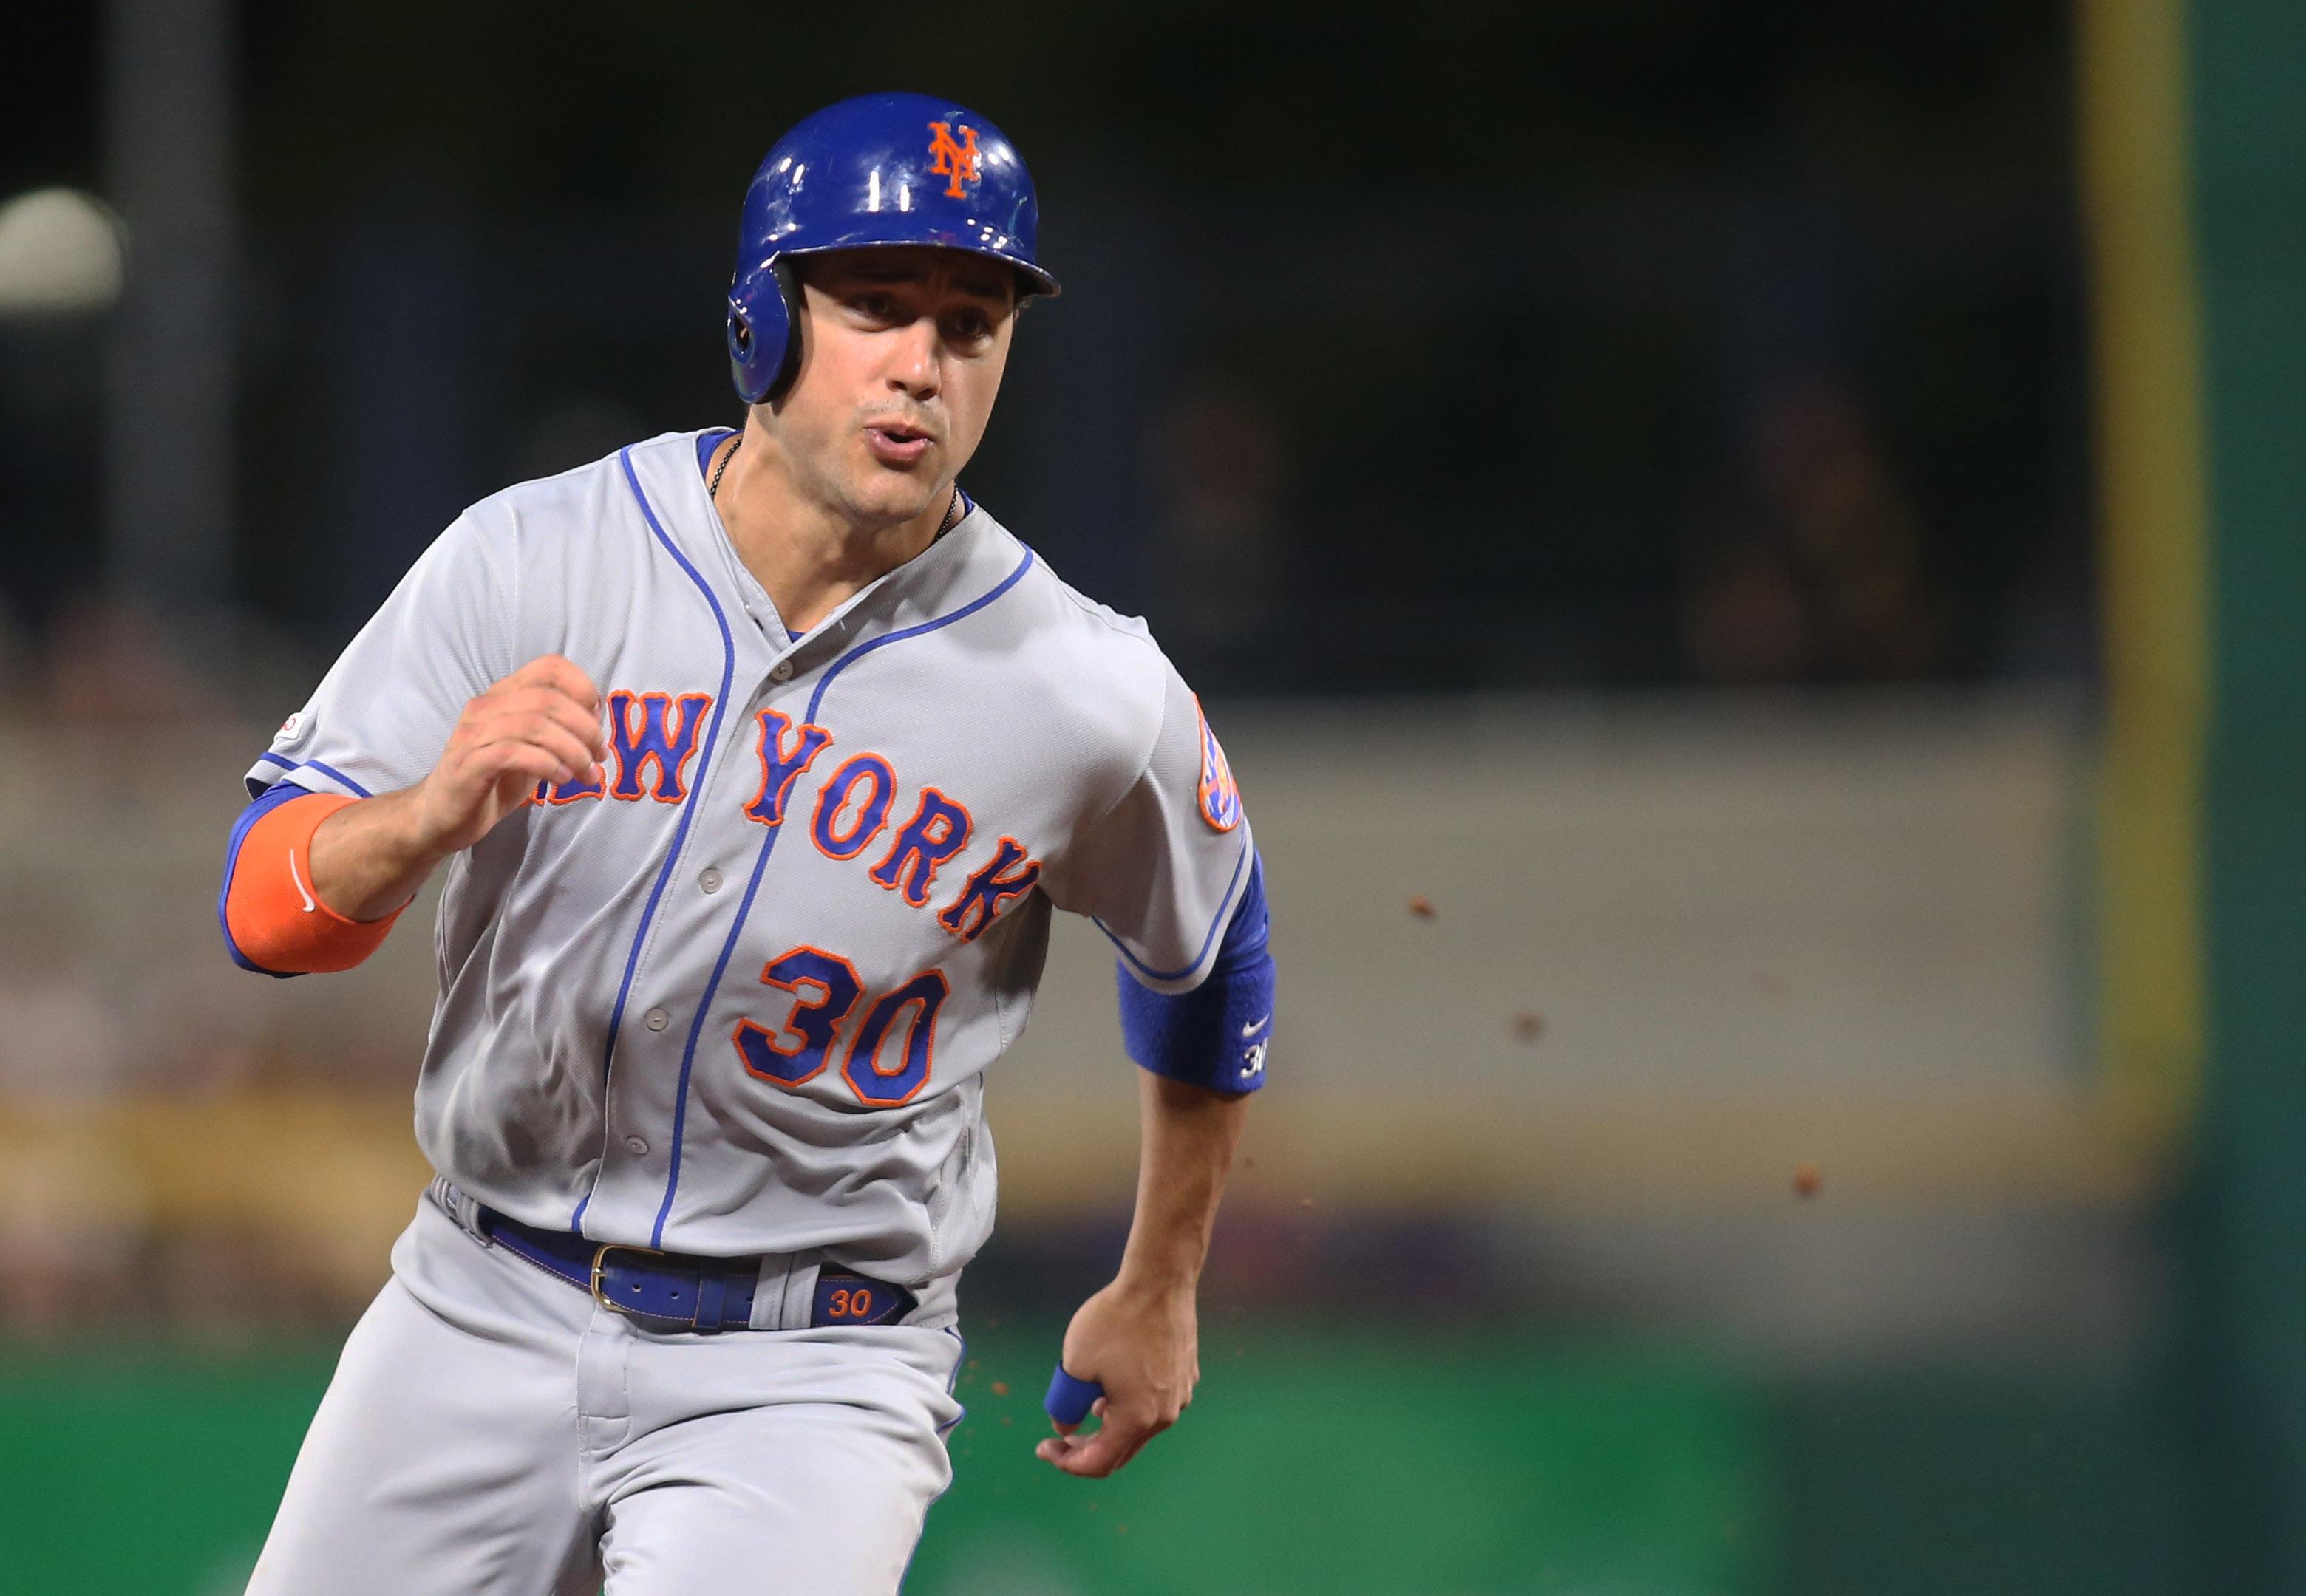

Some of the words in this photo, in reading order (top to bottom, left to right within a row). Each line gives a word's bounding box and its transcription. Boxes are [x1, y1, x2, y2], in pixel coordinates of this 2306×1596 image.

[928, 121, 982, 200] NY
[744, 709, 1041, 942] YORK
[732, 945, 950, 1107] 30
[829, 1289, 872, 1317] 30
